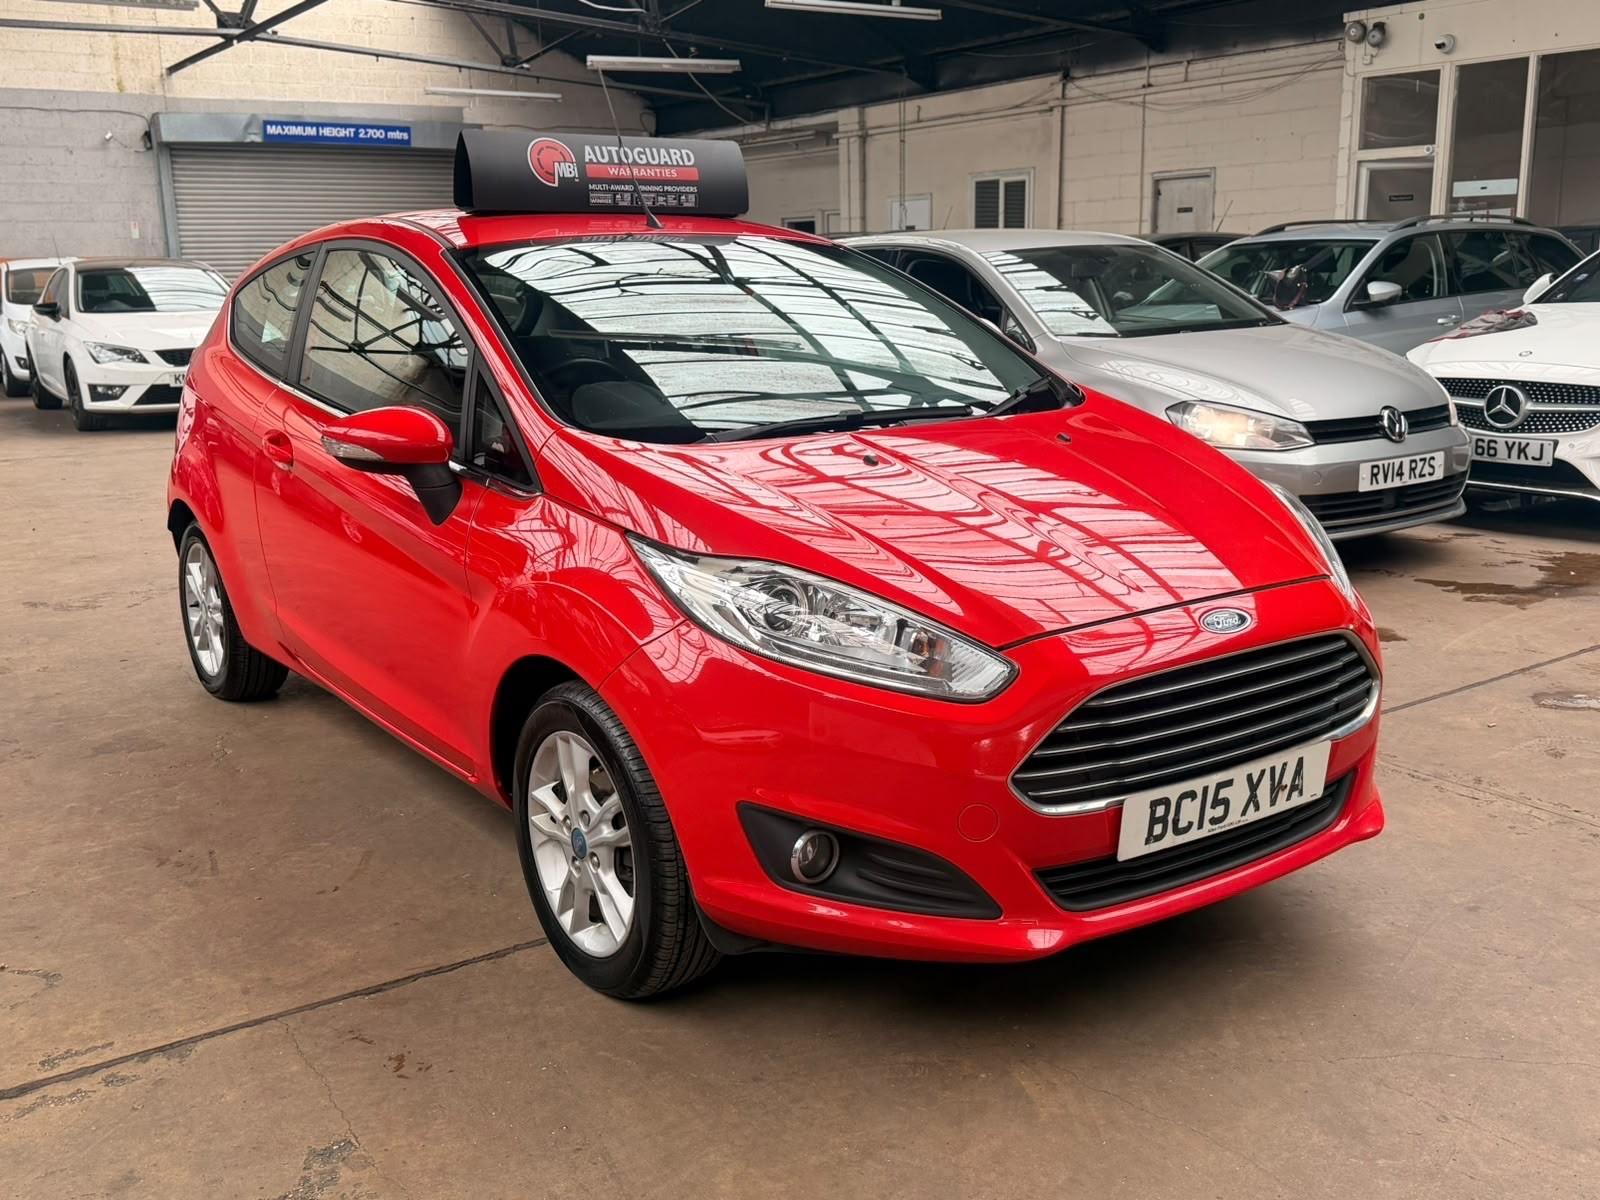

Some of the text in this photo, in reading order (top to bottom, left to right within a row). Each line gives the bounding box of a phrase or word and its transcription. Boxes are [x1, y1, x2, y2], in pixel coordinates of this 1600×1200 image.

[266, 125, 317, 136] MAXIMUM
[319, 127, 355, 138] HEIGHT
[387, 131, 409, 140] mtrs
[584, 145, 695, 166] AUTOGUARD
[607, 166, 678, 178] WARRANTIES
[588, 184, 635, 192] MULTI-AWARD
[1475, 439, 1545, 461] 66 YKJ
[1370, 456, 1436, 486] RV14 RZS
[1213, 613, 1240, 629] Ford
[1144, 757, 1304, 845] BC15 XVA
